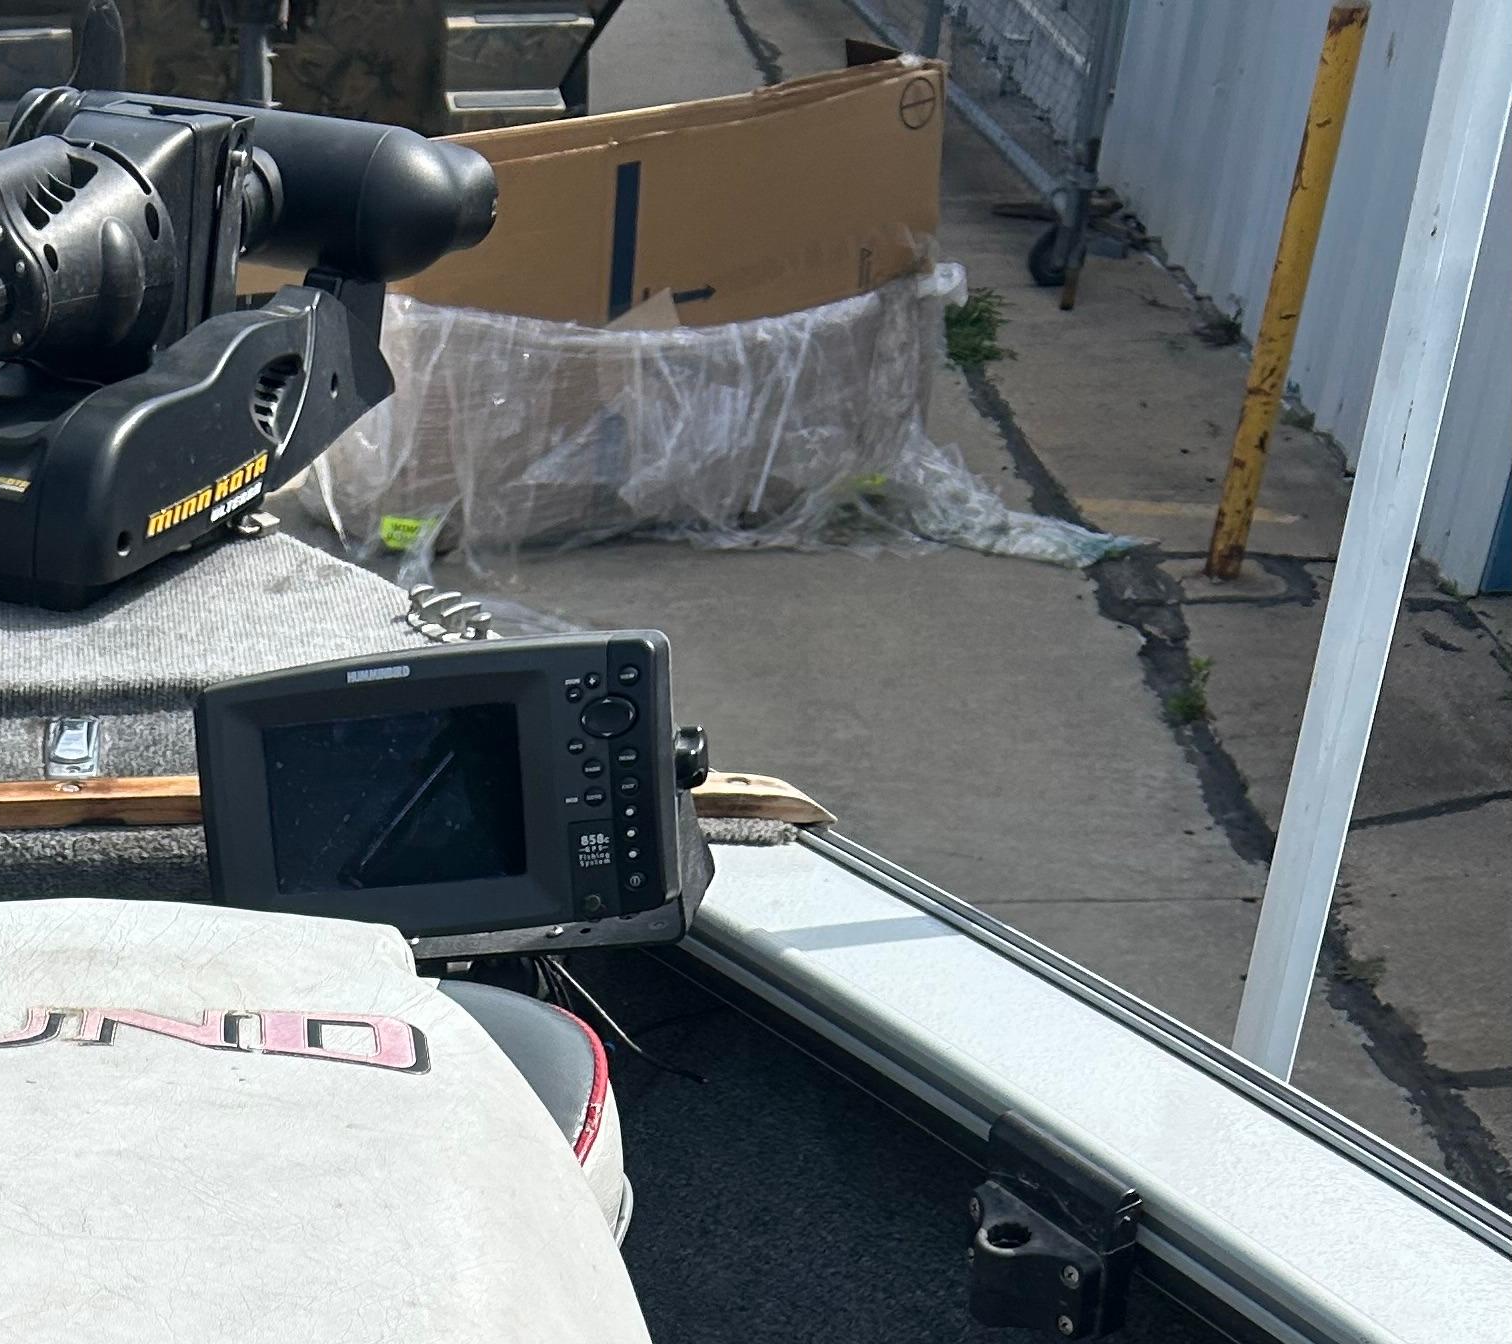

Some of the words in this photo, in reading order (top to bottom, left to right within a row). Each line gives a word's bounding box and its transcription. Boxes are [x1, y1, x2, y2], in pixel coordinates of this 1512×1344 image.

[146, 487, 213, 538] MINN
[214, 452, 269, 502] KOTA
[578, 852, 611, 861] Fishing
[579, 858, 611, 868] System
